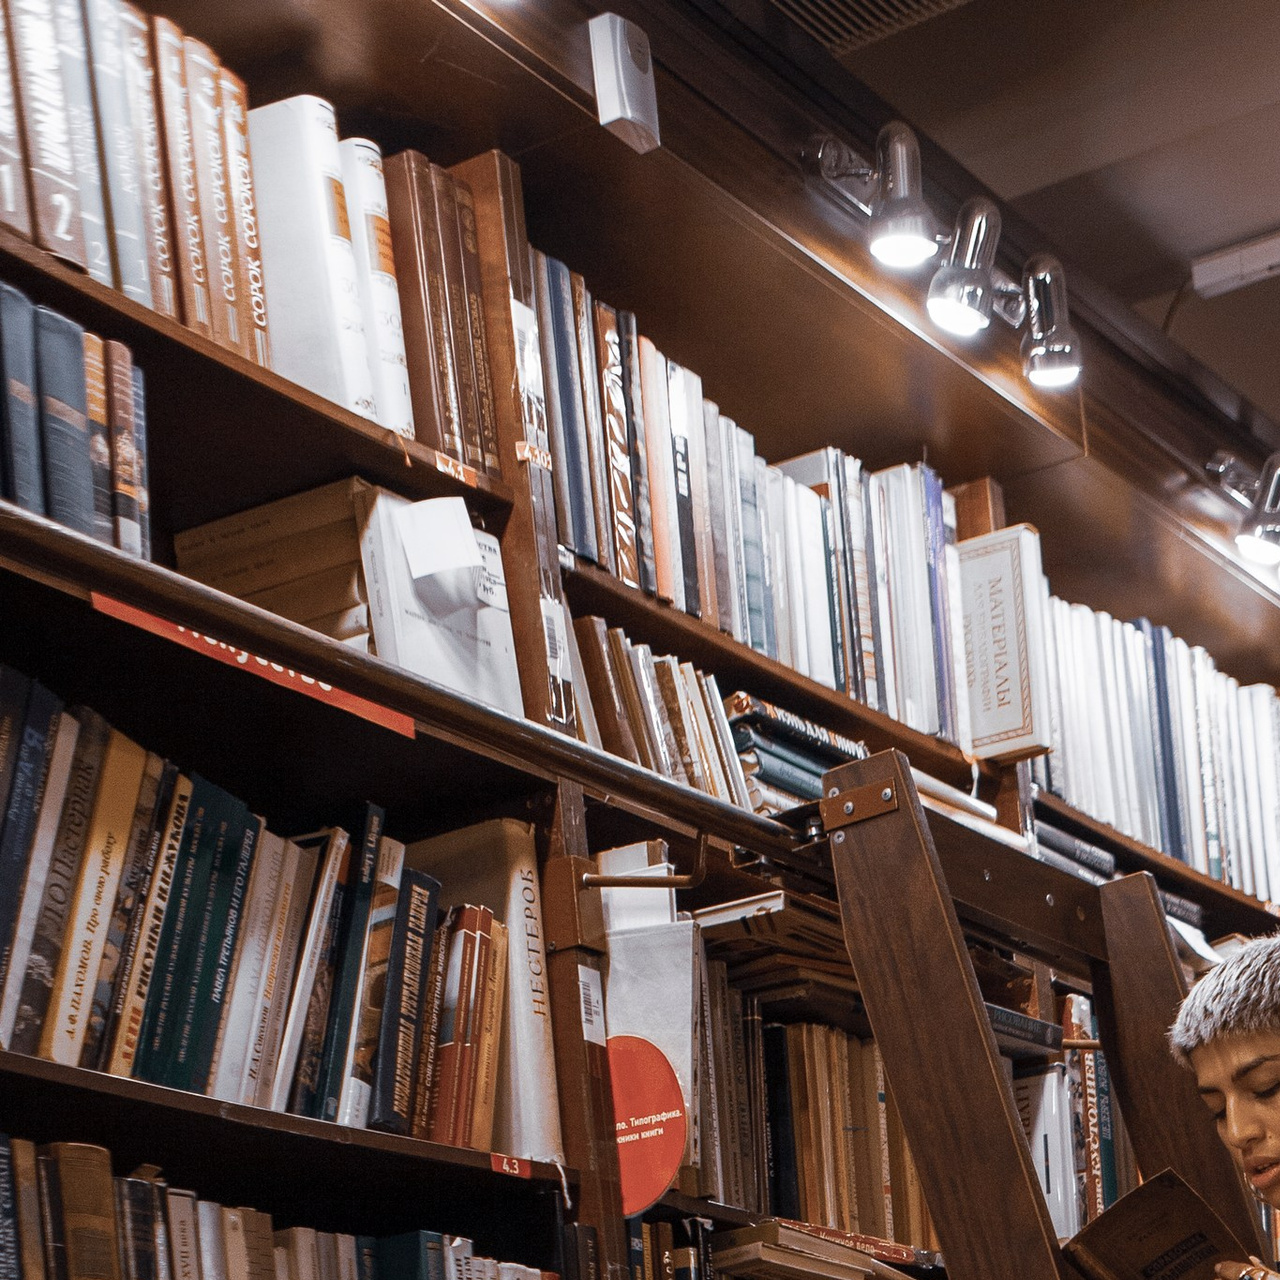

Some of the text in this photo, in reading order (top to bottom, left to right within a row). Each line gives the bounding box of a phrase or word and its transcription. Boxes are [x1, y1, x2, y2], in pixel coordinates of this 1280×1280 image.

[52, 194, 75, 241] 2
[180, 208, 209, 284] СОРОК
[214, 230, 240, 301] СОРОК
[244, 255, 269, 327] СОРОК
[145, 831, 162, 873] АБРАМОВ
[237, 829, 255, 876] ГАЛЕРЕЯ
[232, 876, 245, 897] ЕГО
[133, 906, 163, 999] РИСУНКИ
[218, 909, 239, 966] ТРЕТЬЯКОВ
[519, 867, 546, 1017] НЕСТЕРОВ
[209, 968, 226, 1003] ПАВЕЛ
[389, 885, 430, 1117] ГОСУДАРСТВЕННАЯ ТРЕТЬЯКОВСКАЯ ГАЛЕРЕЯ
[423, 1034, 437, 1087] СОВЕТСКАЯ
[430, 976, 443, 1032] ПОРТРЕТНАЯ
[630, 1110, 682, 1127] Типографика.
[641, 1128, 664, 1139] книги
[1081, 1051, 1104, 1176] КУСТОДИЕВ
[502, 1158, 519, 1174] 4.3
[176, 1219, 188, 1248] века
[179, 1250, 191, 1279] XVII
